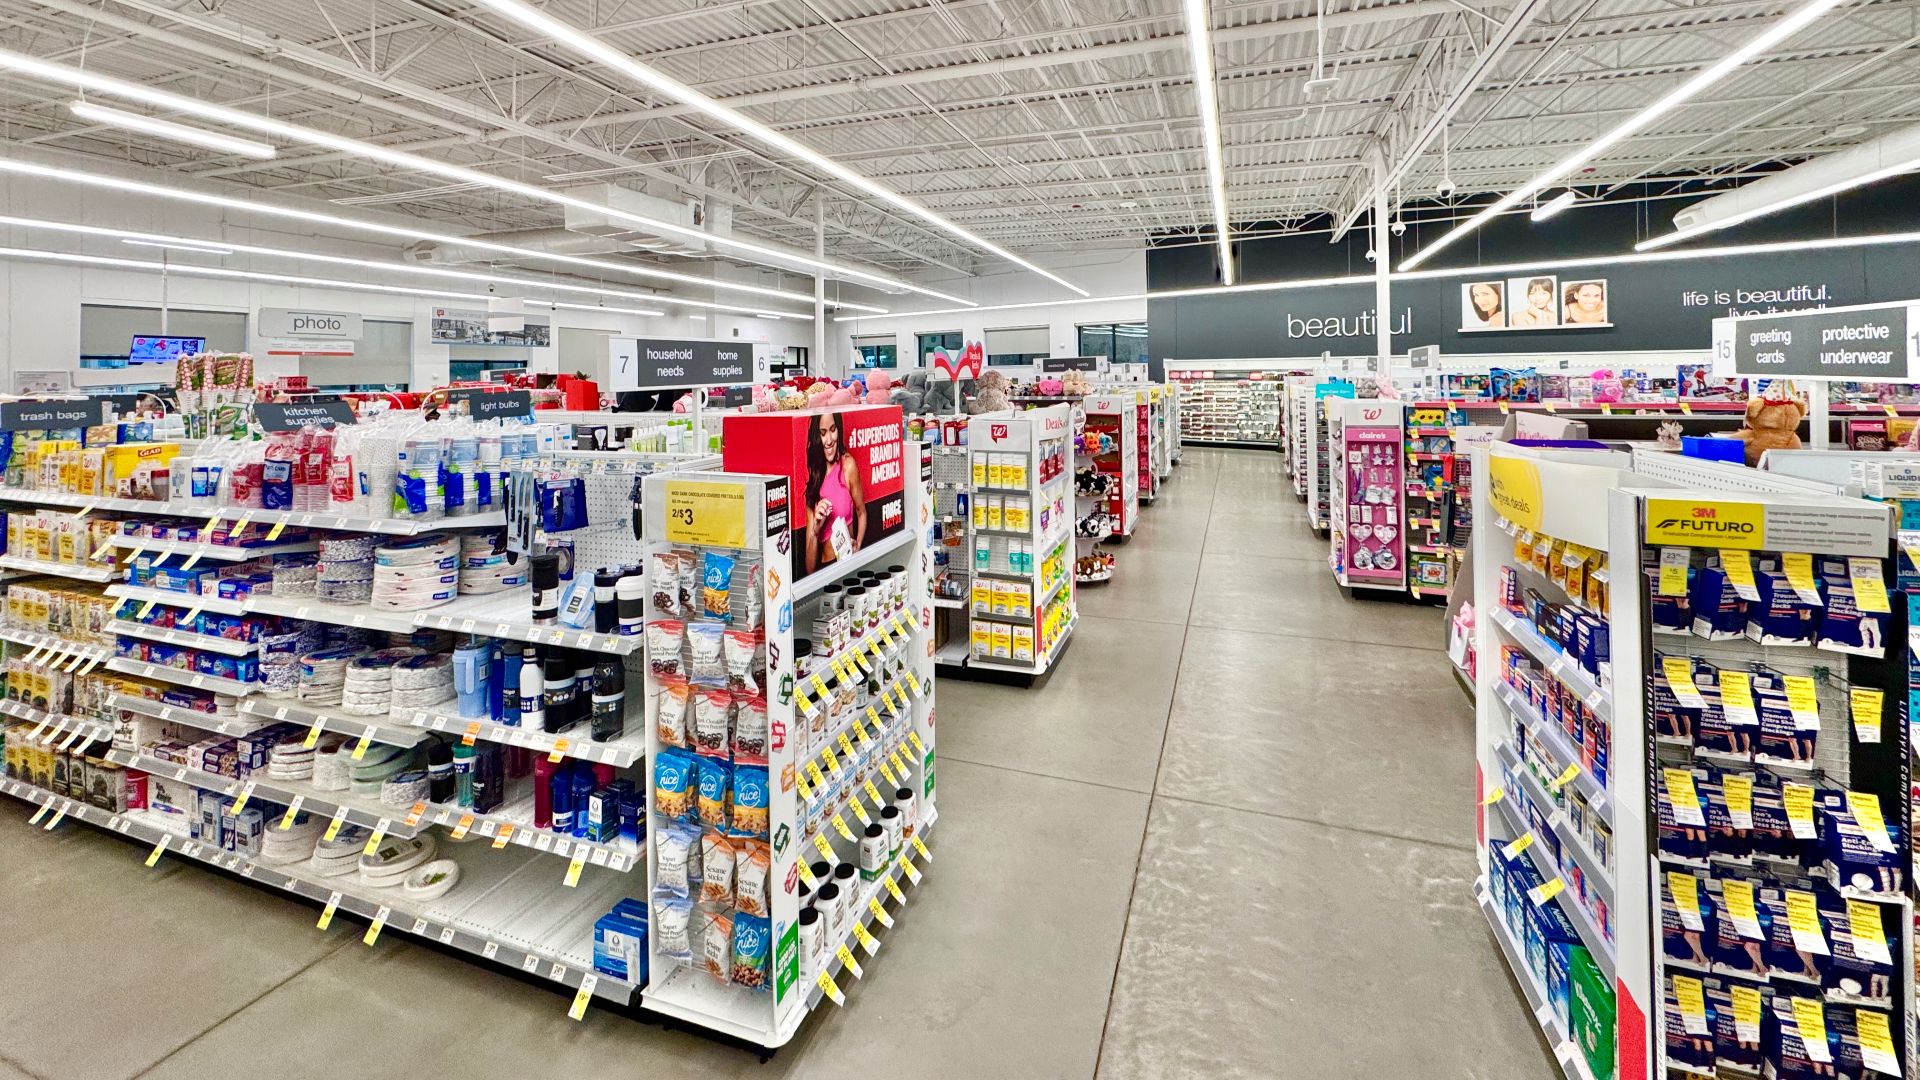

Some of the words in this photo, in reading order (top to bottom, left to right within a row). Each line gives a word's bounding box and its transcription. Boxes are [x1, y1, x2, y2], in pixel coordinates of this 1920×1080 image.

[1683, 291, 1709, 306] life
[1714, 290, 1731, 305] is
[1737, 284, 1832, 304] beautiful.
[293, 315, 341, 331] photo
[1287, 307, 1412, 339] beautiul
[1750, 328, 1792, 347] greeting
[1822, 322, 1890, 345] protective
[647, 348, 693, 360] household
[717, 350, 738, 360] home
[1716, 340, 1731, 359] 15
[758, 356, 765, 371] 6
[1756, 350, 1785, 364] cards
[1820, 349, 1893, 365] underwear
[619, 355, 629, 374] 7
[657, 365, 685, 377] needs
[712, 366, 743, 378] supplies
[283, 407, 328, 417] kitchen
[480, 402, 497, 413] light
[499, 399, 520, 410] bulbs
[20, 412, 53, 421] trash
[57, 409, 87, 420] bags
[285, 416, 335, 427] supplies
[849, 428, 857, 449] #1
[857, 422, 900, 447] SUPERFOODS
[1358, 431, 1387, 440] claire's
[139, 447, 161, 457] GLAD
[870, 444, 892, 465] BRAND
[892, 442, 900, 459] IN
[871, 461, 900, 485] AMERICA
[767, 485, 787, 501] FORCE
[882, 499, 902, 522] FORCE
[1691, 507, 1716, 519] 3M
[1680, 519, 1754, 534] FUTURO
[1646, 674, 1654, 731] Lifestyle
[1700, 722, 1733, 730] Stockings
[1761, 727, 1795, 736] Stockings
[1899, 700, 1908, 760] Lifestyle
[1648, 735, 1657, 814] Compression
[637, 806, 647, 816] PU
[1900, 764, 1909, 851] Compression
[705, 865, 727, 875] Sesame
[707, 873, 724, 882] Sticks
[738, 878, 759, 889] Sesame
[739, 885, 756, 895] Sticks
[705, 939, 722, 951] Sesame
[1782, 1050, 1806, 1060] Socks
